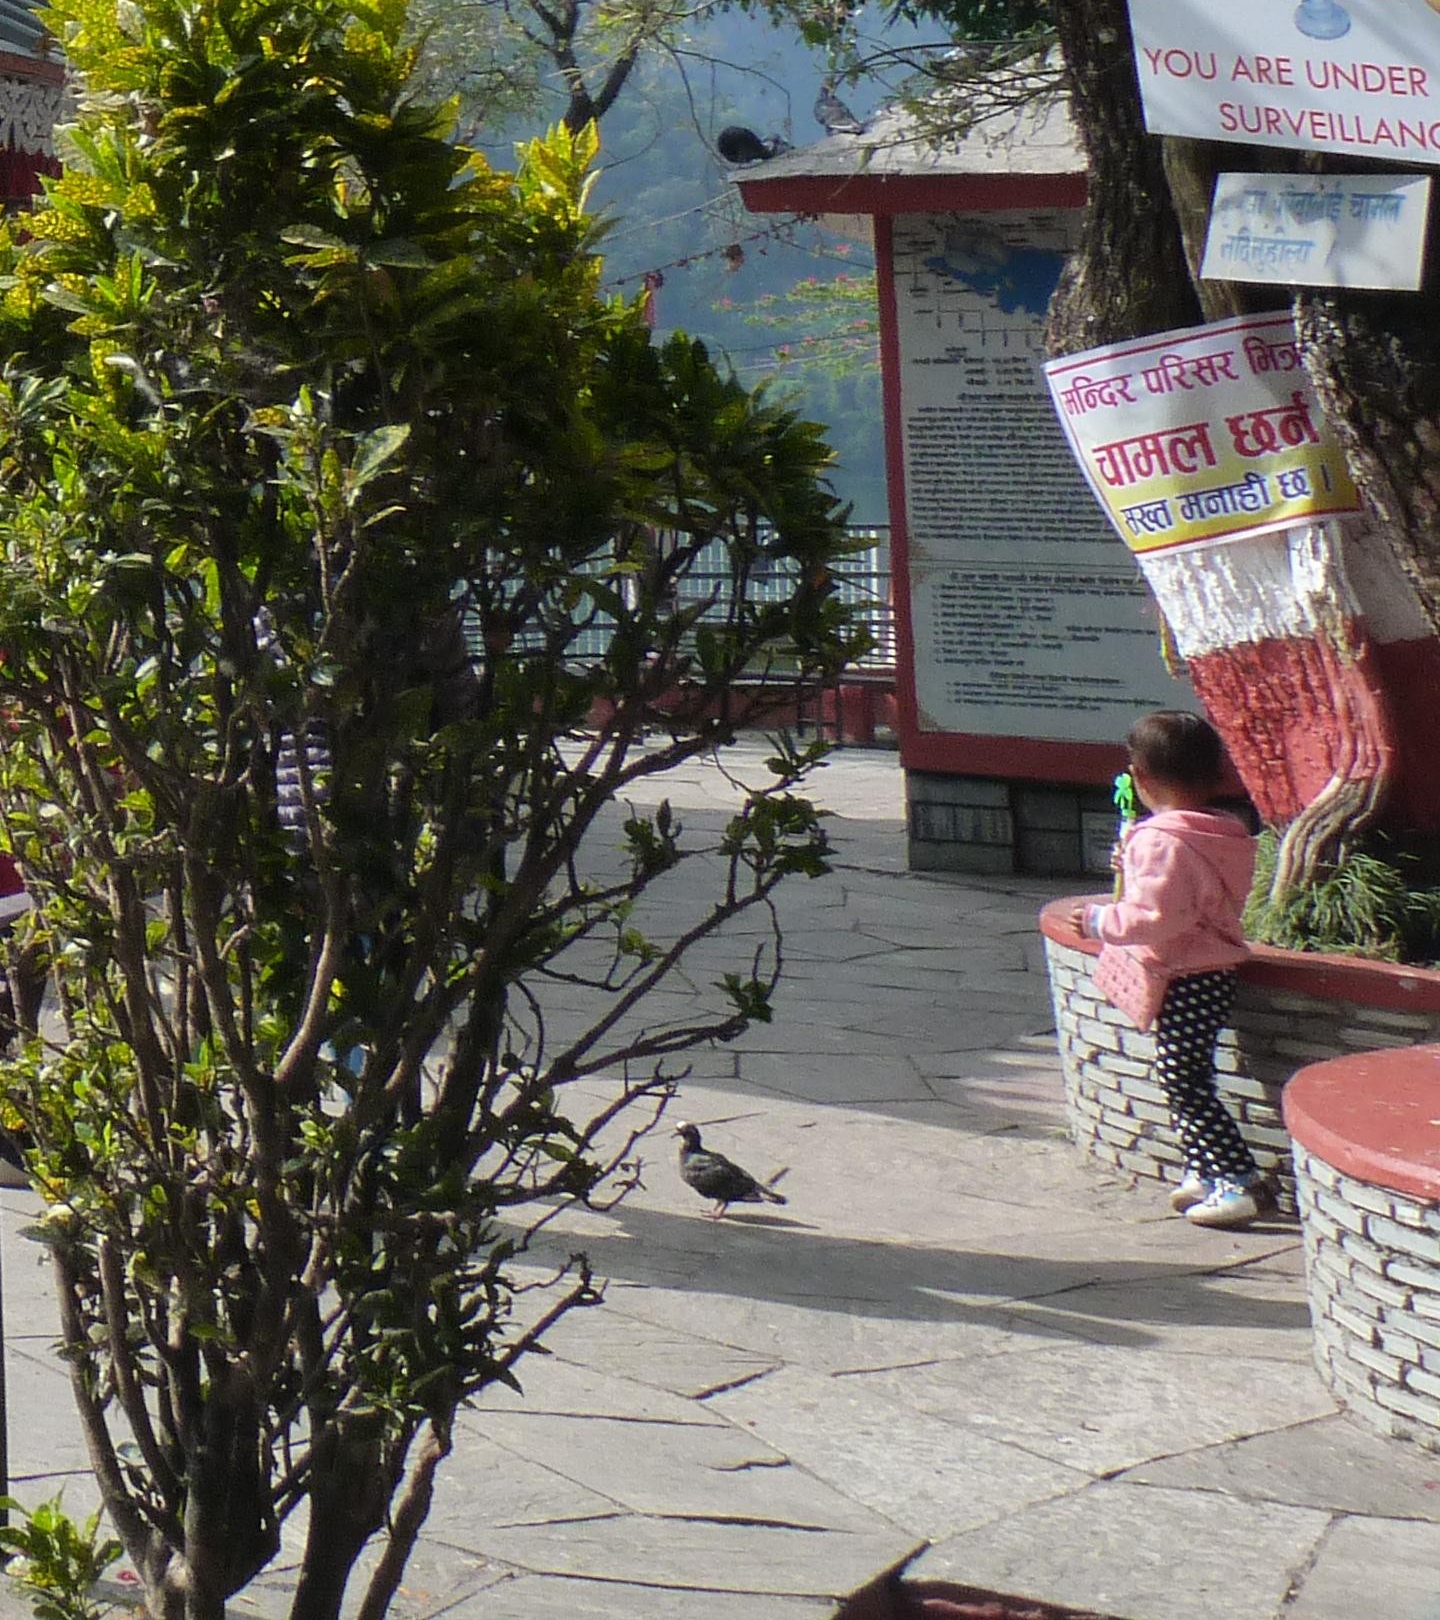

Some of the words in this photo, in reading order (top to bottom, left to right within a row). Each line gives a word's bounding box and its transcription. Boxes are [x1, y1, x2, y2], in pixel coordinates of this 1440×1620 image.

[1143, 47, 1218, 79] YOU
[1230, 55, 1294, 86] ARE
[1306, 60, 1429, 97] UNDER
[1061, 375, 1137, 416] मन्दिर
[1141, 354, 1239, 394] परिसर
[1092, 422, 1216, 487] चामल
[1225, 391, 1320, 458] छर्न
[1120, 499, 1173, 536] सख्त
[1175, 472, 1270, 522] मनाही
[1276, 468, 1312, 500] छ
